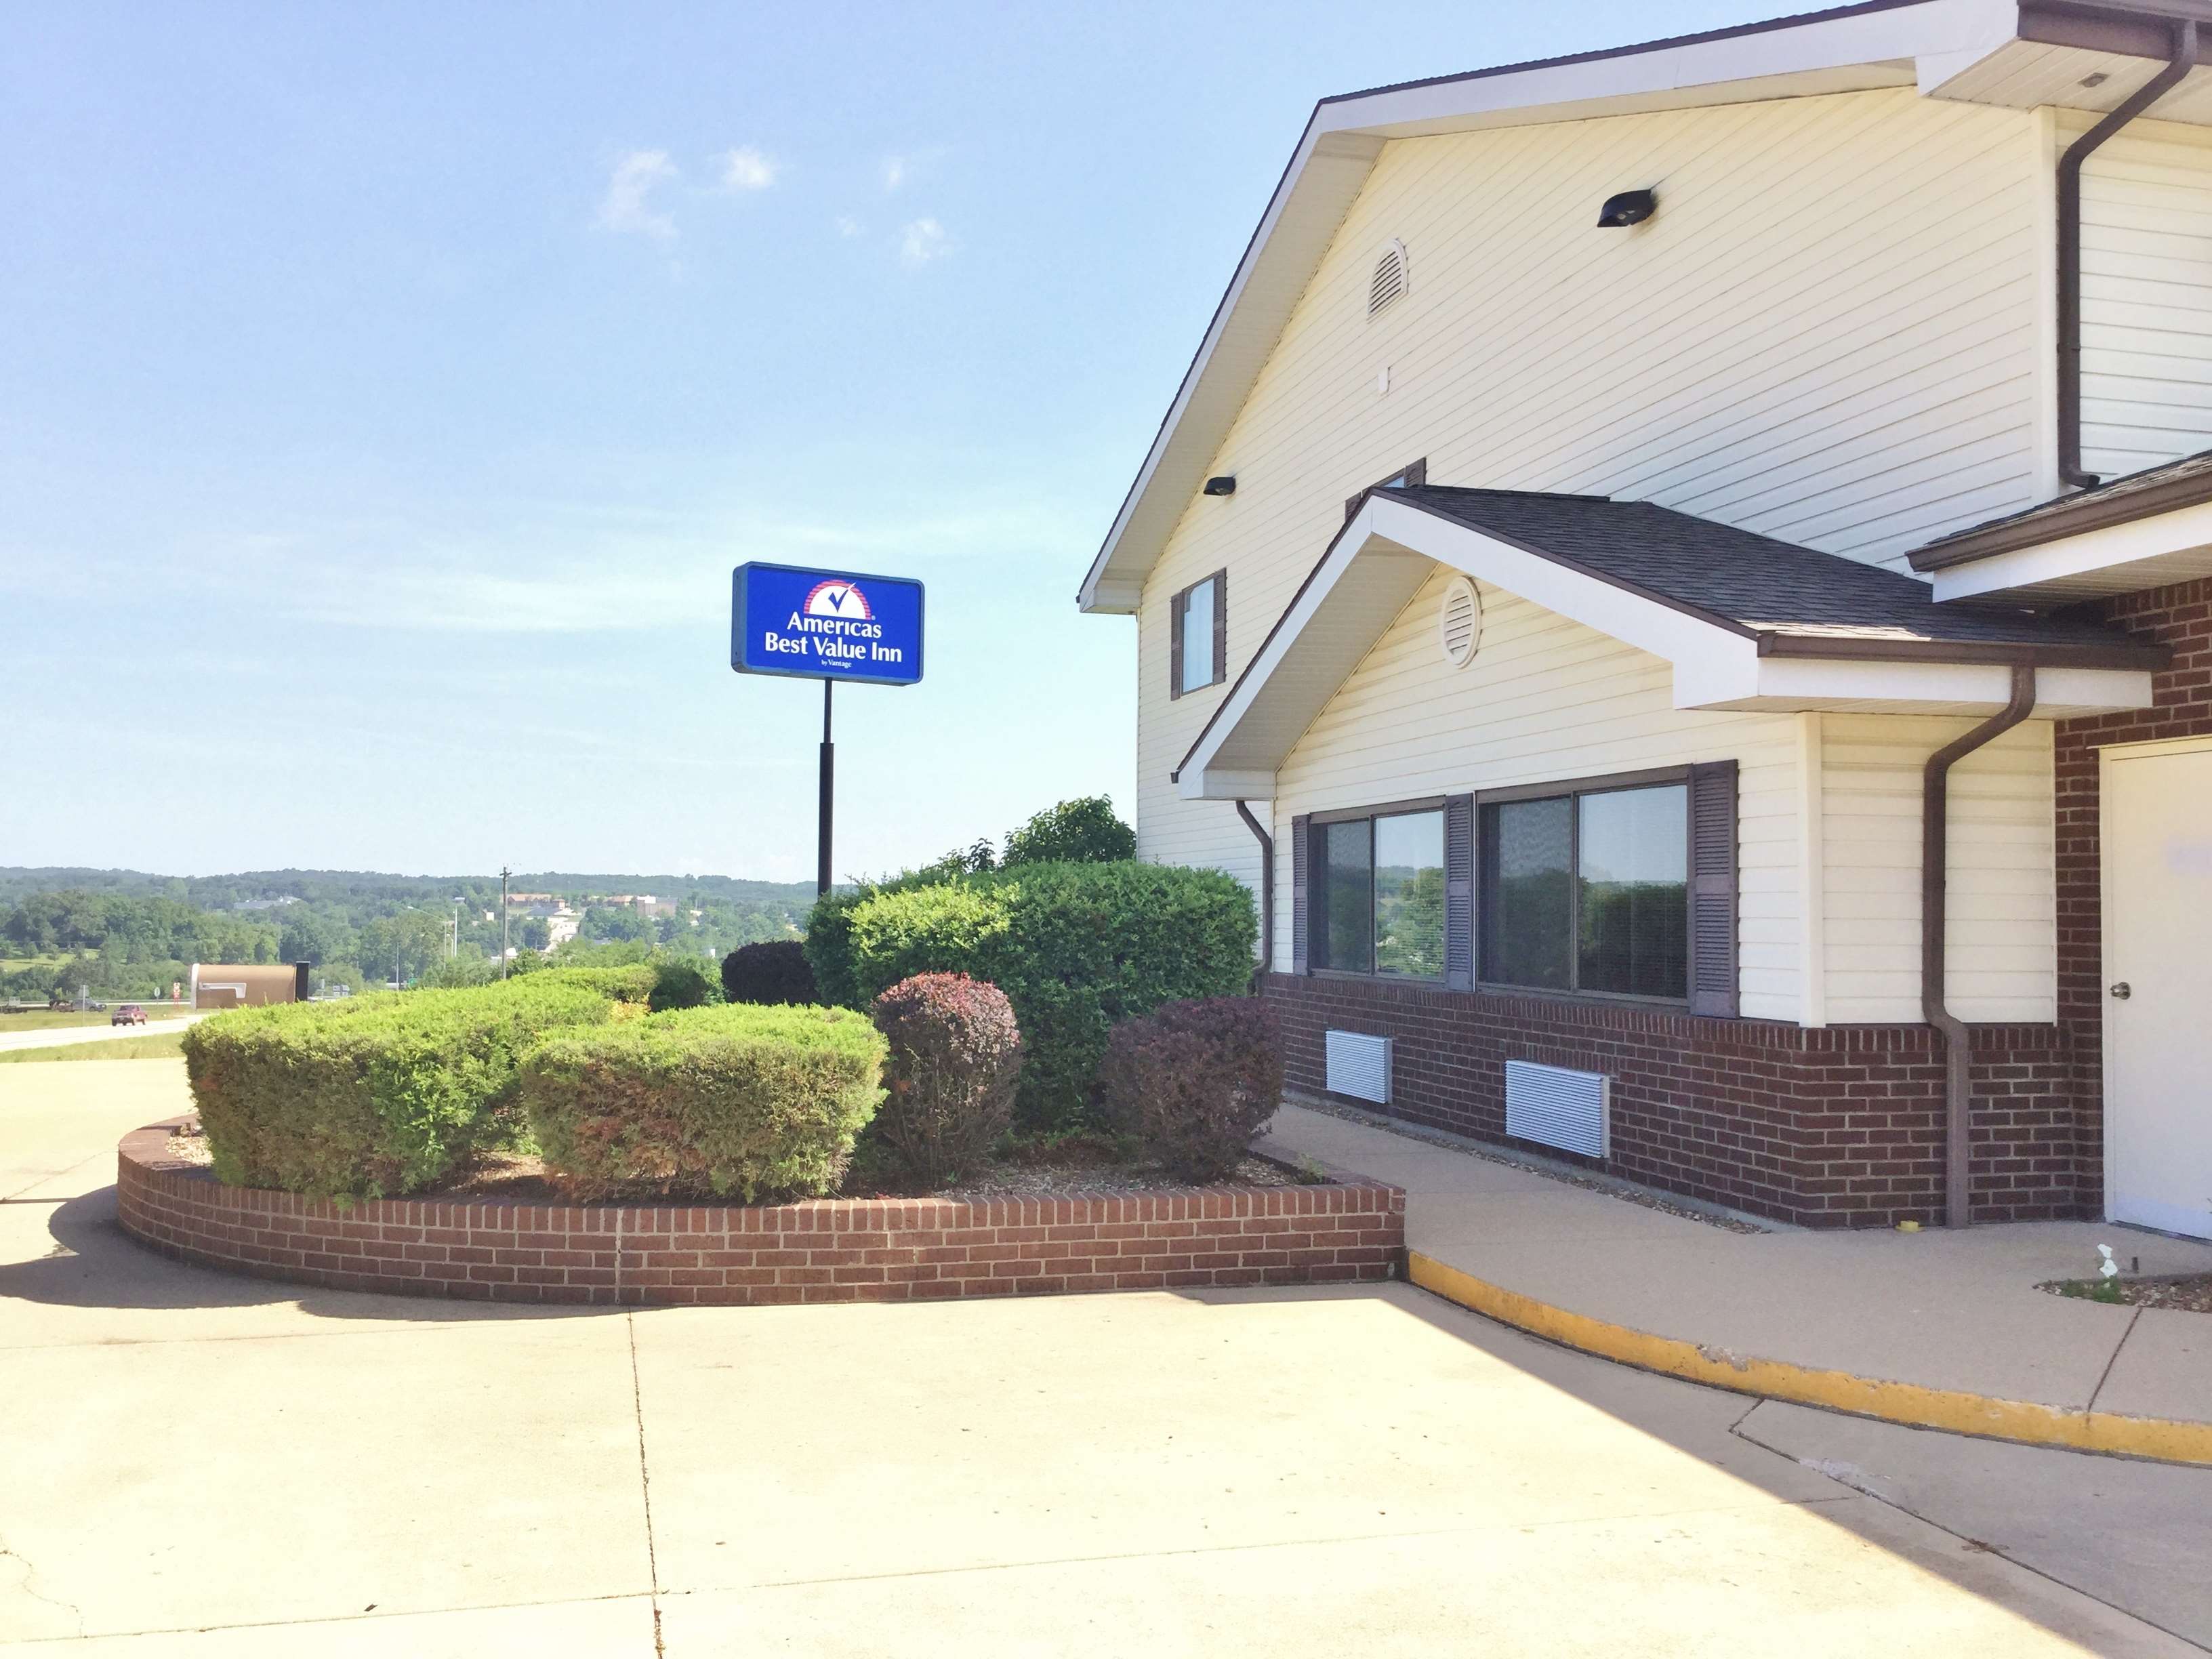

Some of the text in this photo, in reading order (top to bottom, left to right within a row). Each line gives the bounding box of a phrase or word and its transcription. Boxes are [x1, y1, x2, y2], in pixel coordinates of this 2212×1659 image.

[787, 611, 882, 638] Americas
[765, 632, 902, 663] Best Value Inn
[821, 659, 852, 669] by Vantage
